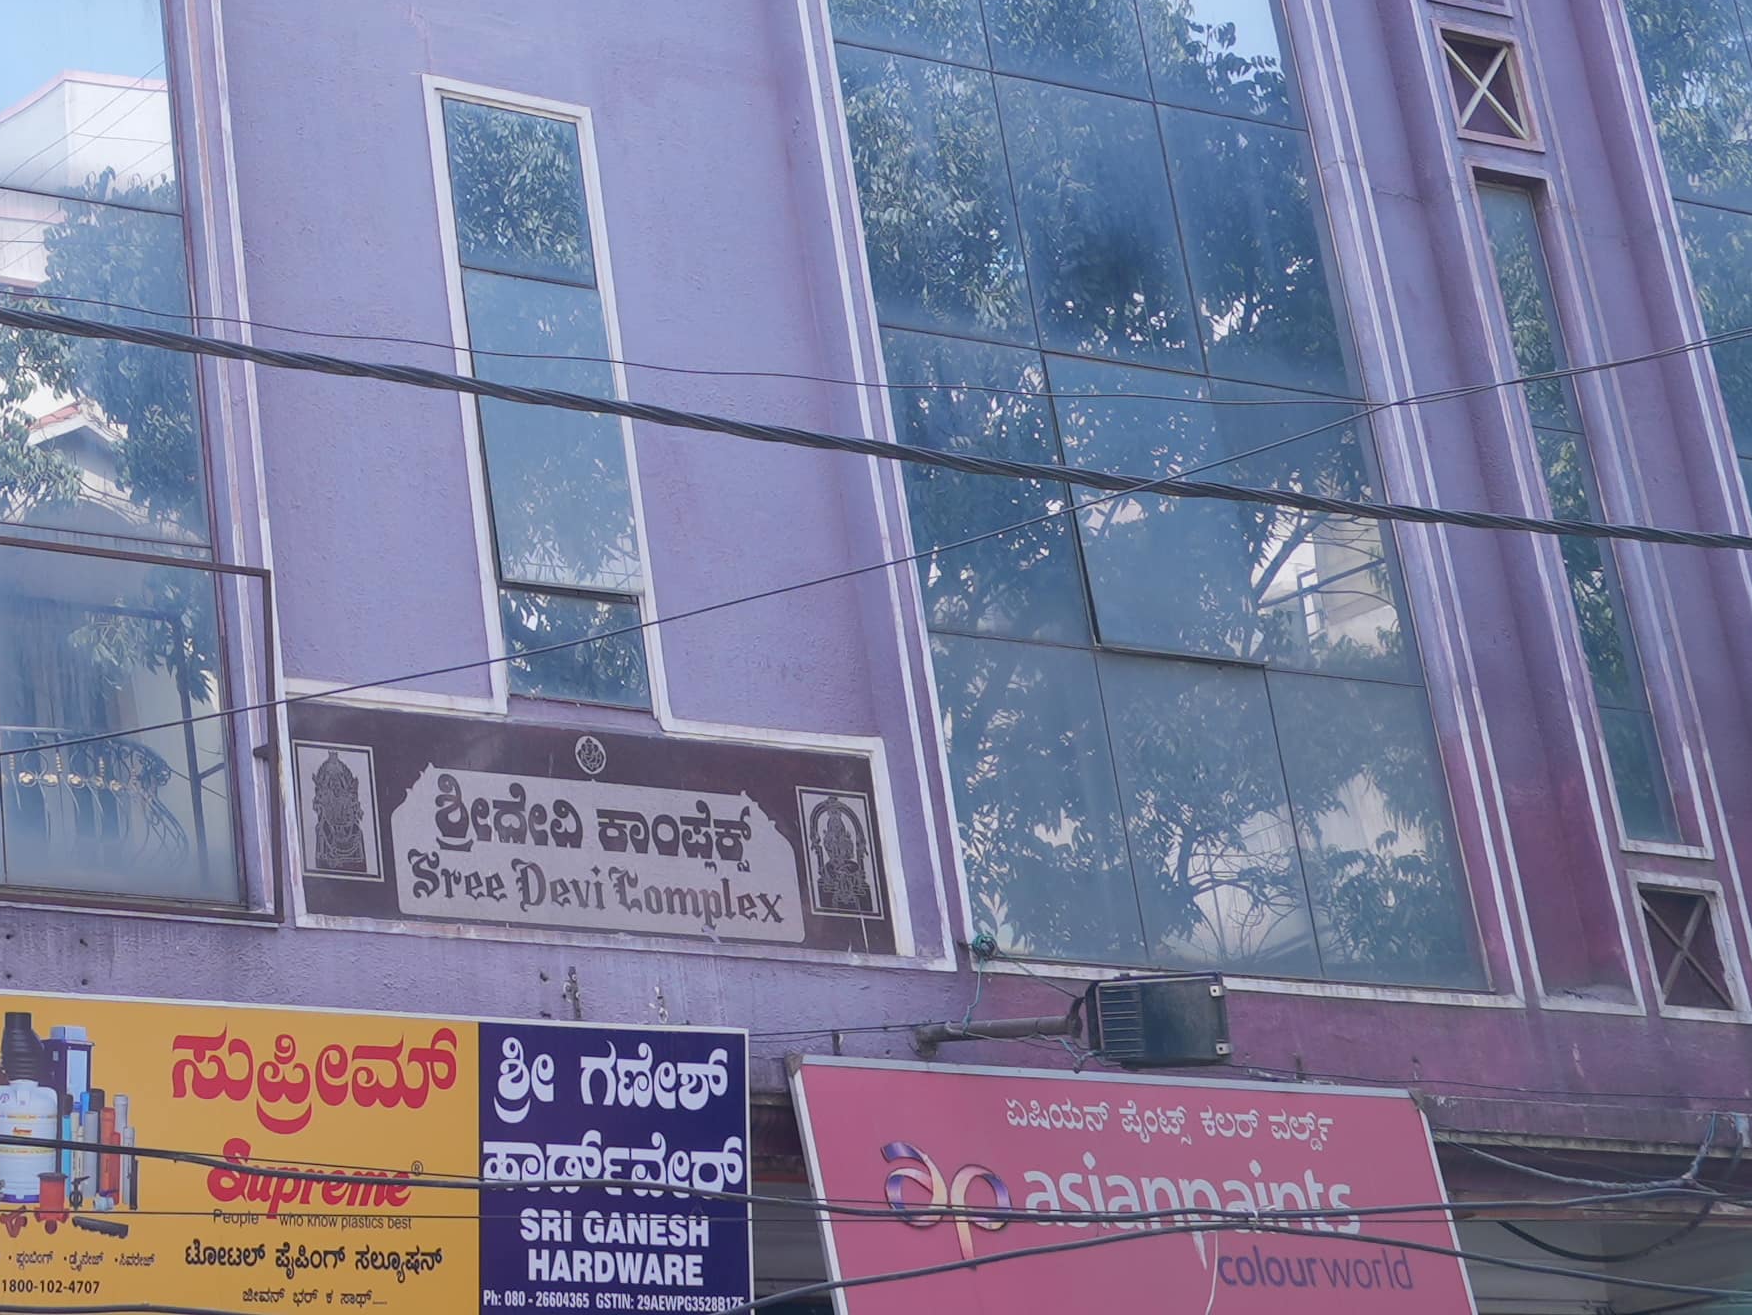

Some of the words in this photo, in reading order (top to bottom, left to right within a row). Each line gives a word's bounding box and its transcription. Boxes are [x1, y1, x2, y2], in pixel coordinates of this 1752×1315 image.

[434, 773, 583, 852] ಶ್ರೀದೇವಿ
[597, 800, 752, 872] ಕಾಂಪ್ಲೆಕ್ಸ್
[408, 849, 508, 902] Sree
[511, 858, 606, 912] Devi
[608, 867, 784, 931] Complex
[172, 1021, 457, 1134] ಸುಪ್ರೀಮ್
[494, 1037, 554, 1123] ಶ್ರೀ
[580, 1040, 728, 1110] ಗಣೇಶ್
[1200, 1106, 1259, 1138] ಕಲರ್
[213, 1209, 259, 1227] People
[279, 1212, 305, 1227] who
[307, 1213, 337, 1228] know
[341, 1214, 384, 1231] plastics
[387, 1215, 412, 1229] best
[520, 1208, 572, 1242] SRI
[582, 1211, 709, 1247] GANESH
[185, 1239, 266, 1266] ಟೋಟಲ್
[275, 1242, 346, 1279] ಪೈಪಿಂಗ್
[527, 1249, 704, 1286] HARDWARE
[2, 1279, 100, 1294] 1800-102-4707
[484, 1290, 502, 1306] Ph:
[505, 1291, 525, 1307] 080
[536, 1291, 589, 1308] 26604365
[596, 1293, 635, 1310] GSTIN:
